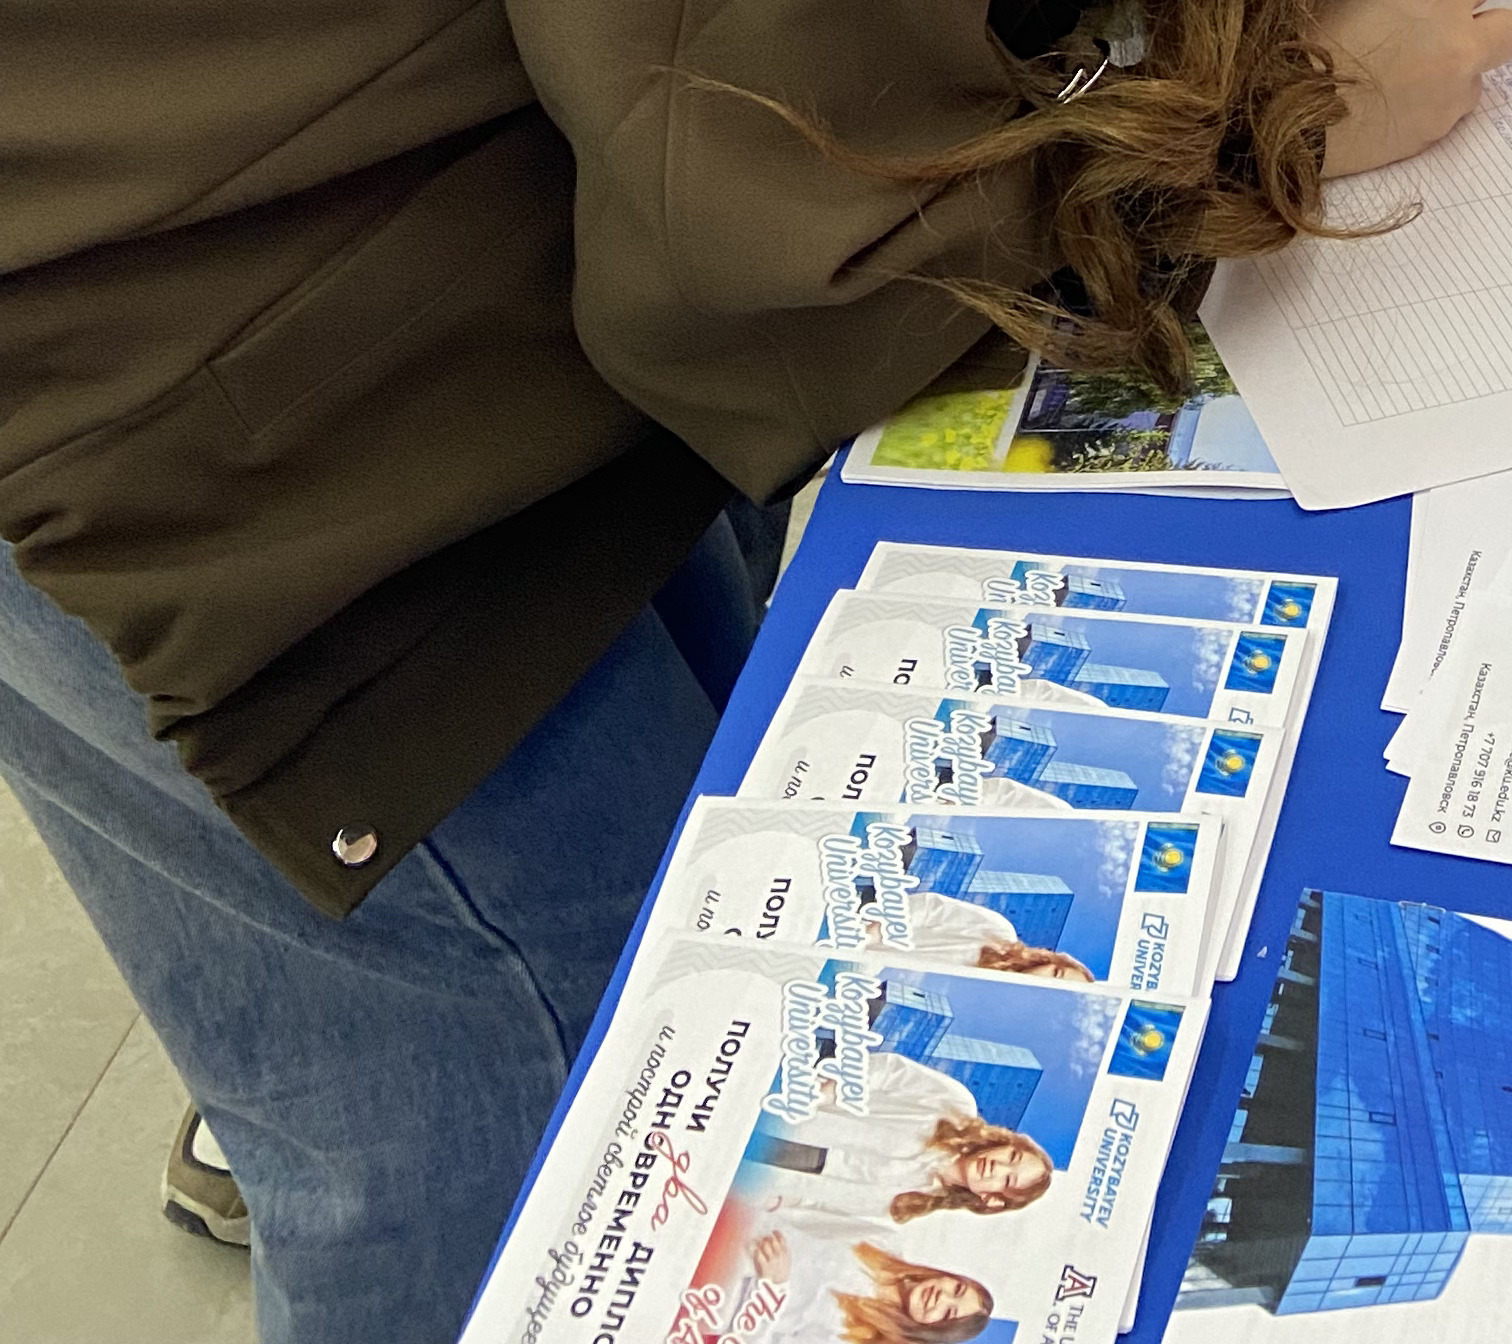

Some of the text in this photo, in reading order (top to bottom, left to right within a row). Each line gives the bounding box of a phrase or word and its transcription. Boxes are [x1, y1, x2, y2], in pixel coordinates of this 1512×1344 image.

[1459, 550, 1482, 598] Казахстан,
[1437, 662, 1492, 813] Казахстан, Петропавловск
[1471, 769, 1486, 788] 916
[1477, 747, 1493, 768] 707
[1462, 804, 1476, 818] 73
[861, 824, 916, 948] Kozybayev
[687, 1019, 750, 1132] ПОЛУЧИ
[767, 982, 828, 1119] University
[822, 973, 883, 1113] Kozybayev
[614, 1043, 667, 1140] построй
[570, 1069, 692, 1318] ОДНОВРЕМЕННО
[571, 1141, 623, 1236] светлое
[1080, 1129, 1118, 1225] UNIVERSITY
[1097, 1134, 1133, 1229] KOZYBAYEV
[741, 1281, 787, 1333] The
[1063, 1304, 1085, 1332] THE
